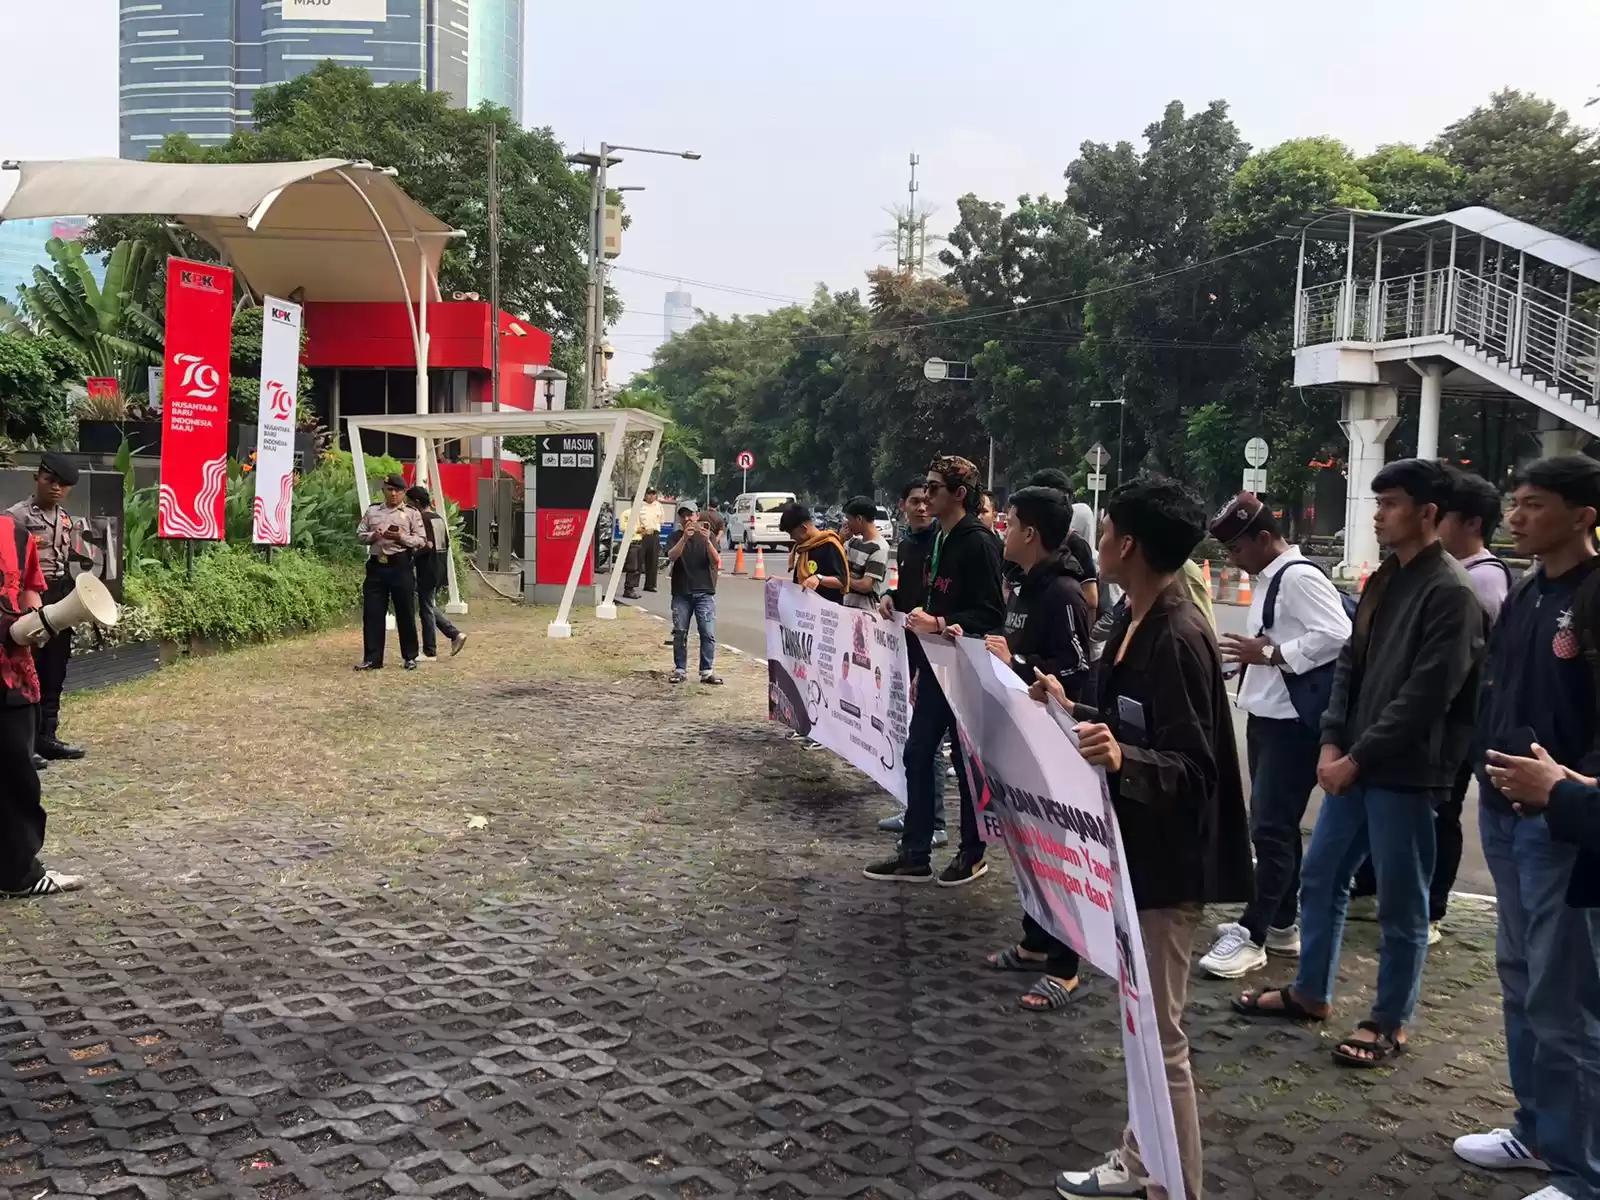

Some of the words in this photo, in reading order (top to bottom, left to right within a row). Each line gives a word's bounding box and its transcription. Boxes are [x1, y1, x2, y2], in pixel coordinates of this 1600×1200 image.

[181, 272, 213, 287] KPK
[271, 307, 291, 322] KPK
[171, 401, 218, 413] NUSANTARA
[171, 408, 193, 416] BARU
[170, 424, 194, 432] MAJU
[171, 417, 213, 428] INDONESIA
[563, 438, 594, 451] MASUK
